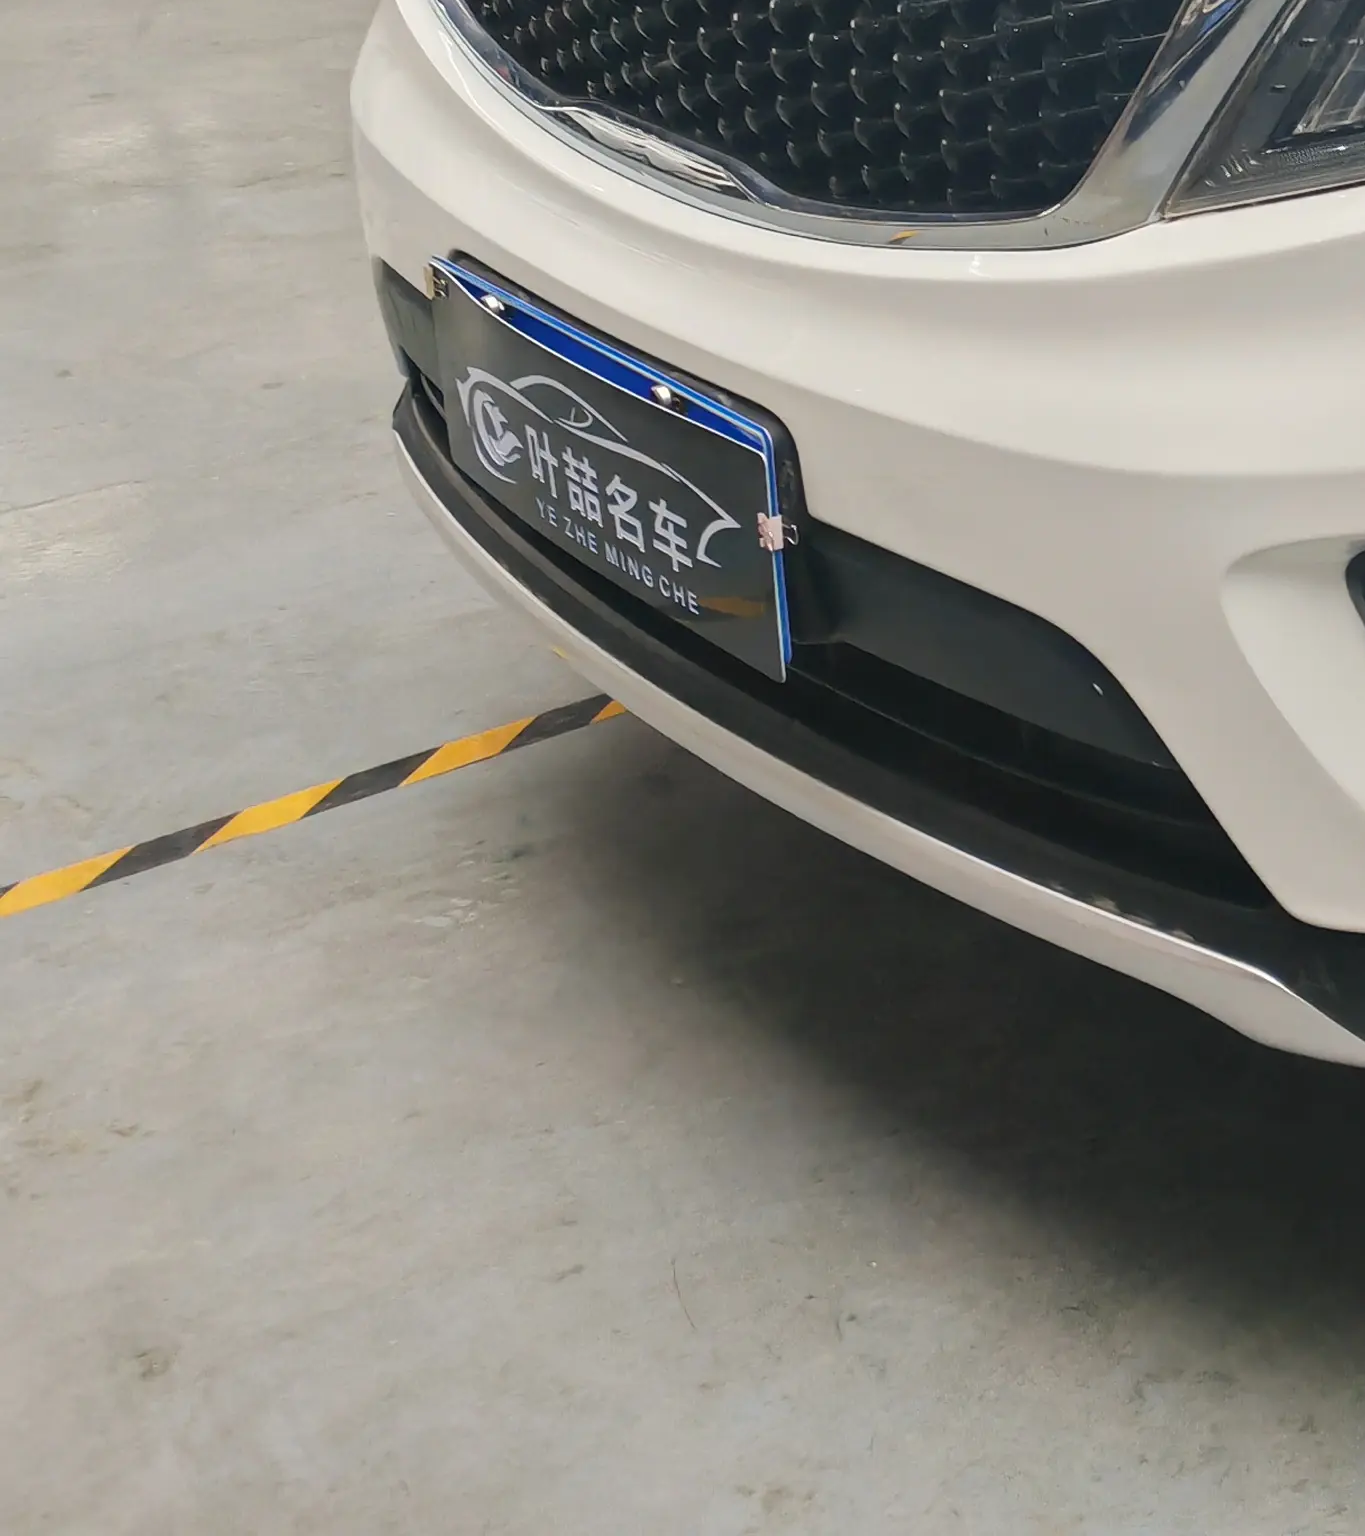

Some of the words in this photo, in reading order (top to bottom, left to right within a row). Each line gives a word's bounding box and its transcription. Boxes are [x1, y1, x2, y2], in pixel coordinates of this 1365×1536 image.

[523, 422, 694, 573] 叶喆名车
[535, 496, 558, 527] YE
[564, 517, 599, 555] ZHE
[604, 539, 655, 588] MING
[658, 574, 700, 616] CHE
